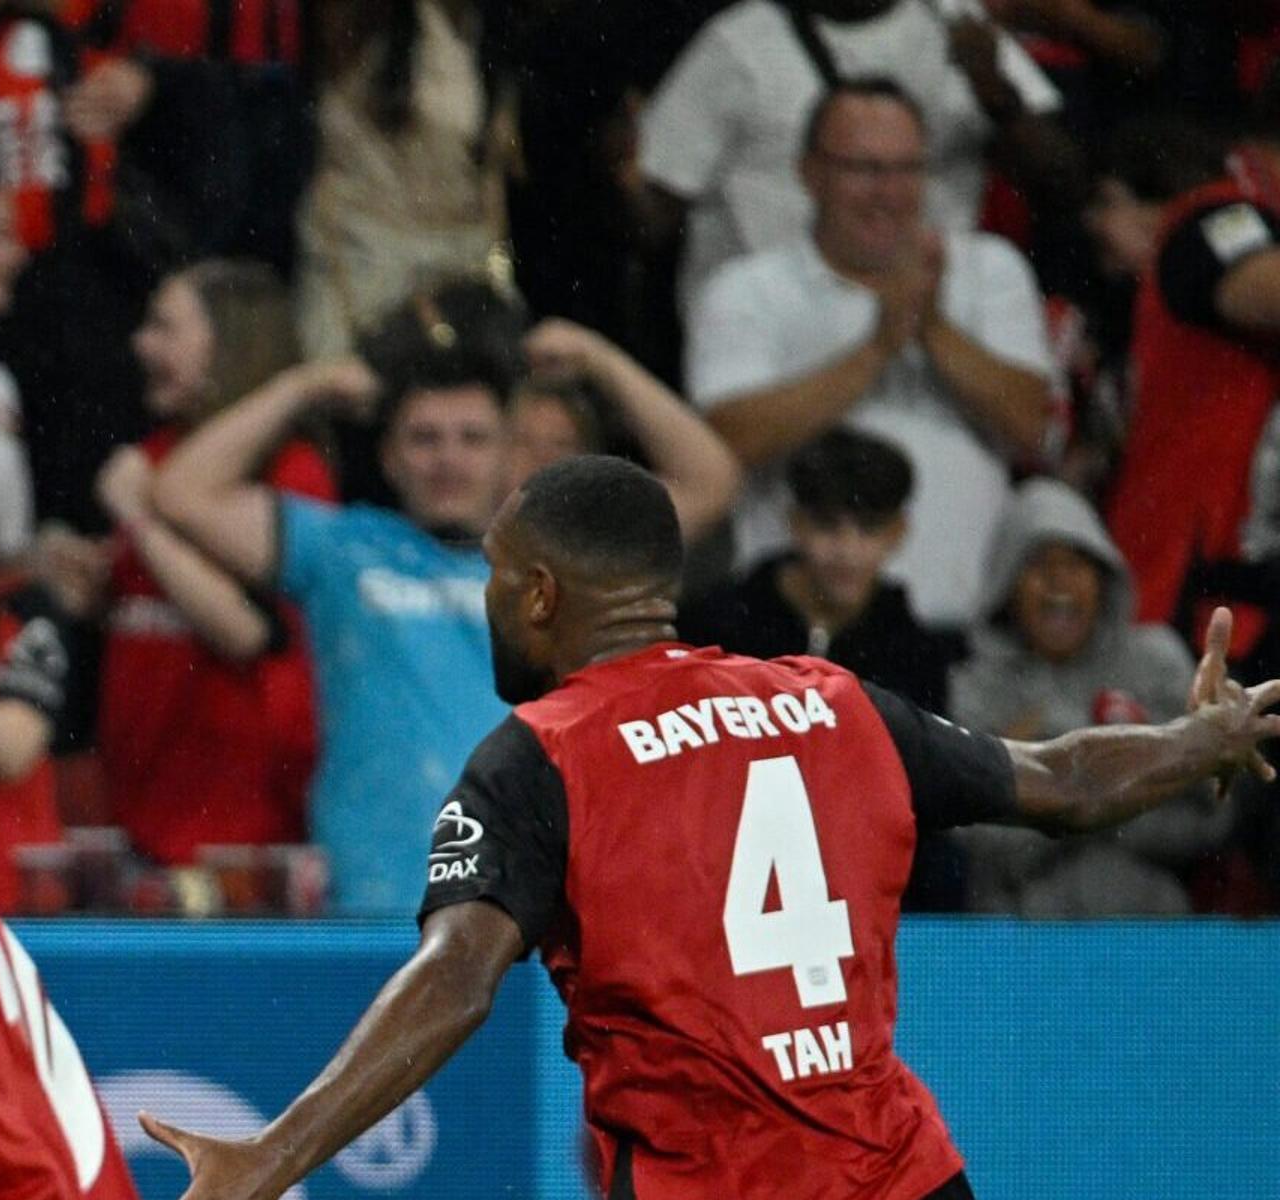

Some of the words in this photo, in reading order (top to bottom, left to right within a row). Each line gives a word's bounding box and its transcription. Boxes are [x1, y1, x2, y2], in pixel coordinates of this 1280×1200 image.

[618, 696, 771, 765] BAYER
[771, 687, 837, 735] 04
[723, 755, 855, 1009] 4
[762, 1021, 854, 1083] TAH
